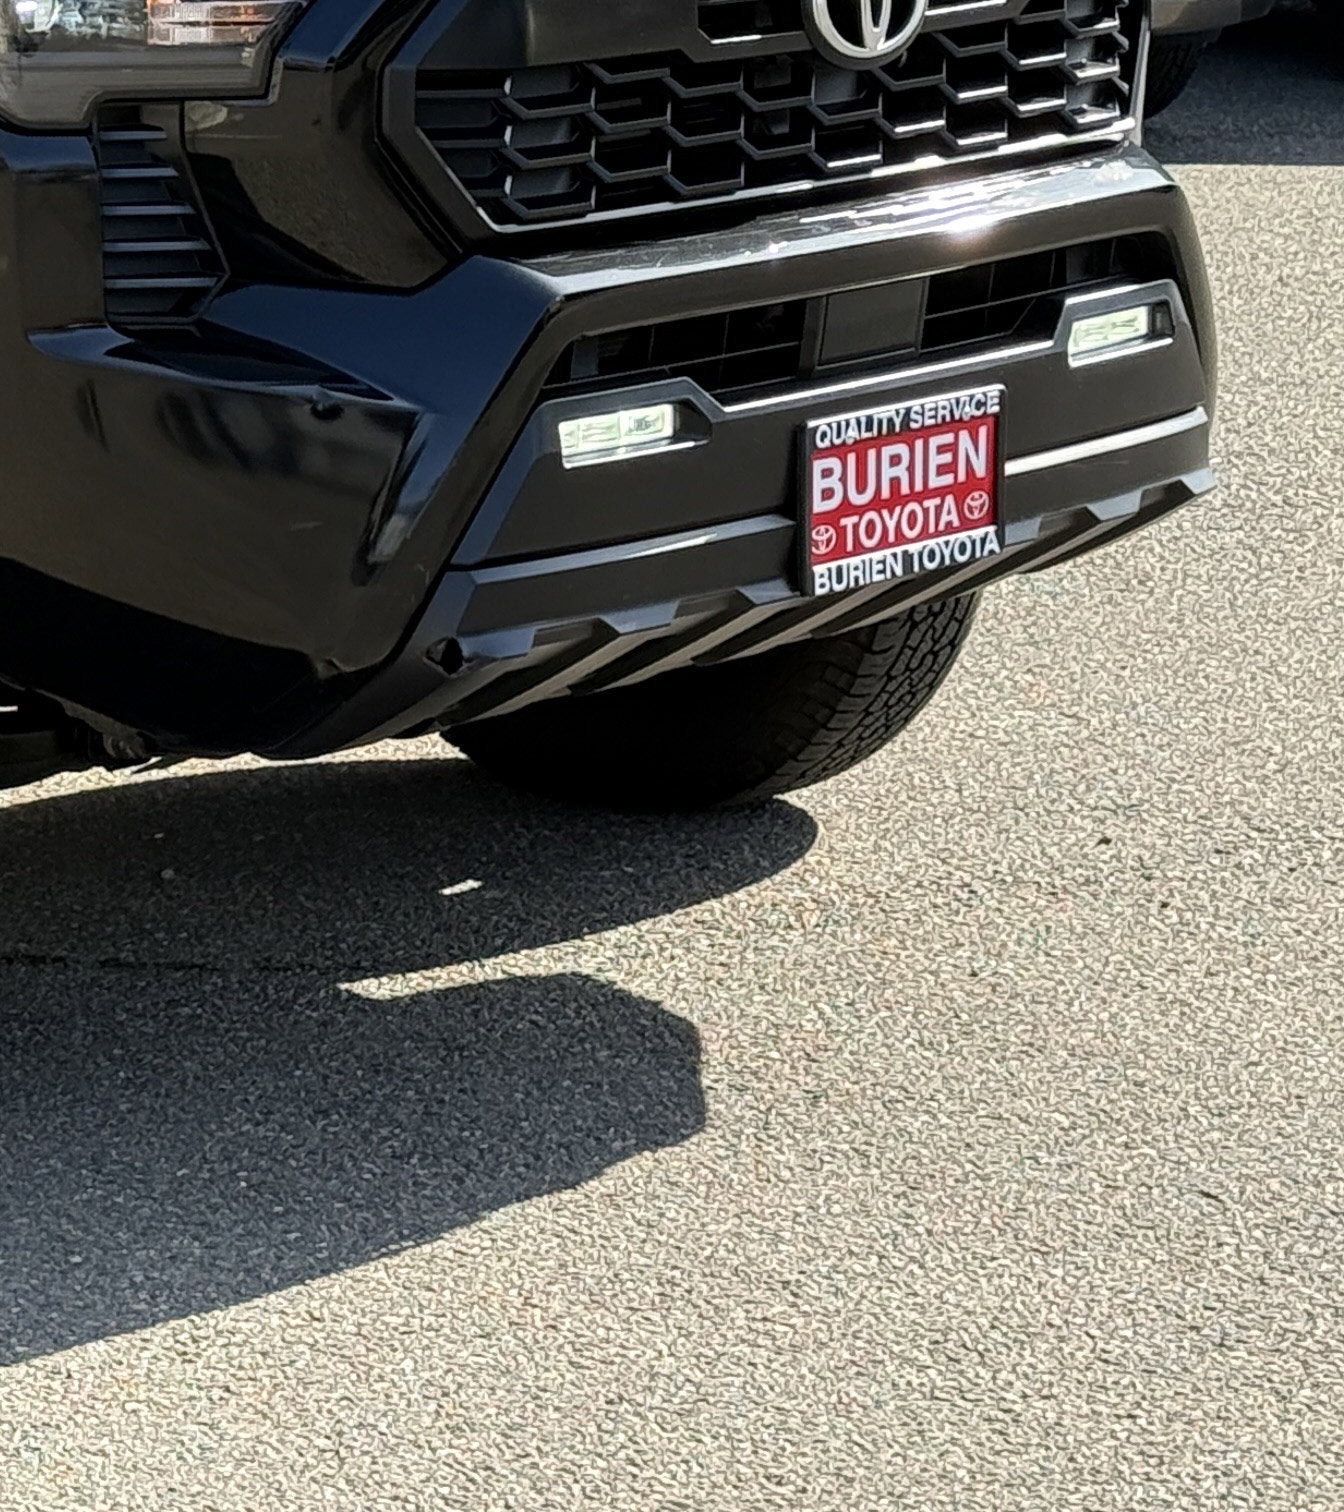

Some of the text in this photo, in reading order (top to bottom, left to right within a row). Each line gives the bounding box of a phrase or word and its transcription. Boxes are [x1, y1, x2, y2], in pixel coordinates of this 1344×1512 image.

[815, 390, 1002, 448] QUALITY SERVICE
[812, 425, 988, 514] BURIEN
[839, 494, 961, 552] TOYOTA
[814, 529, 1002, 596] BURIEN TOYOTA
